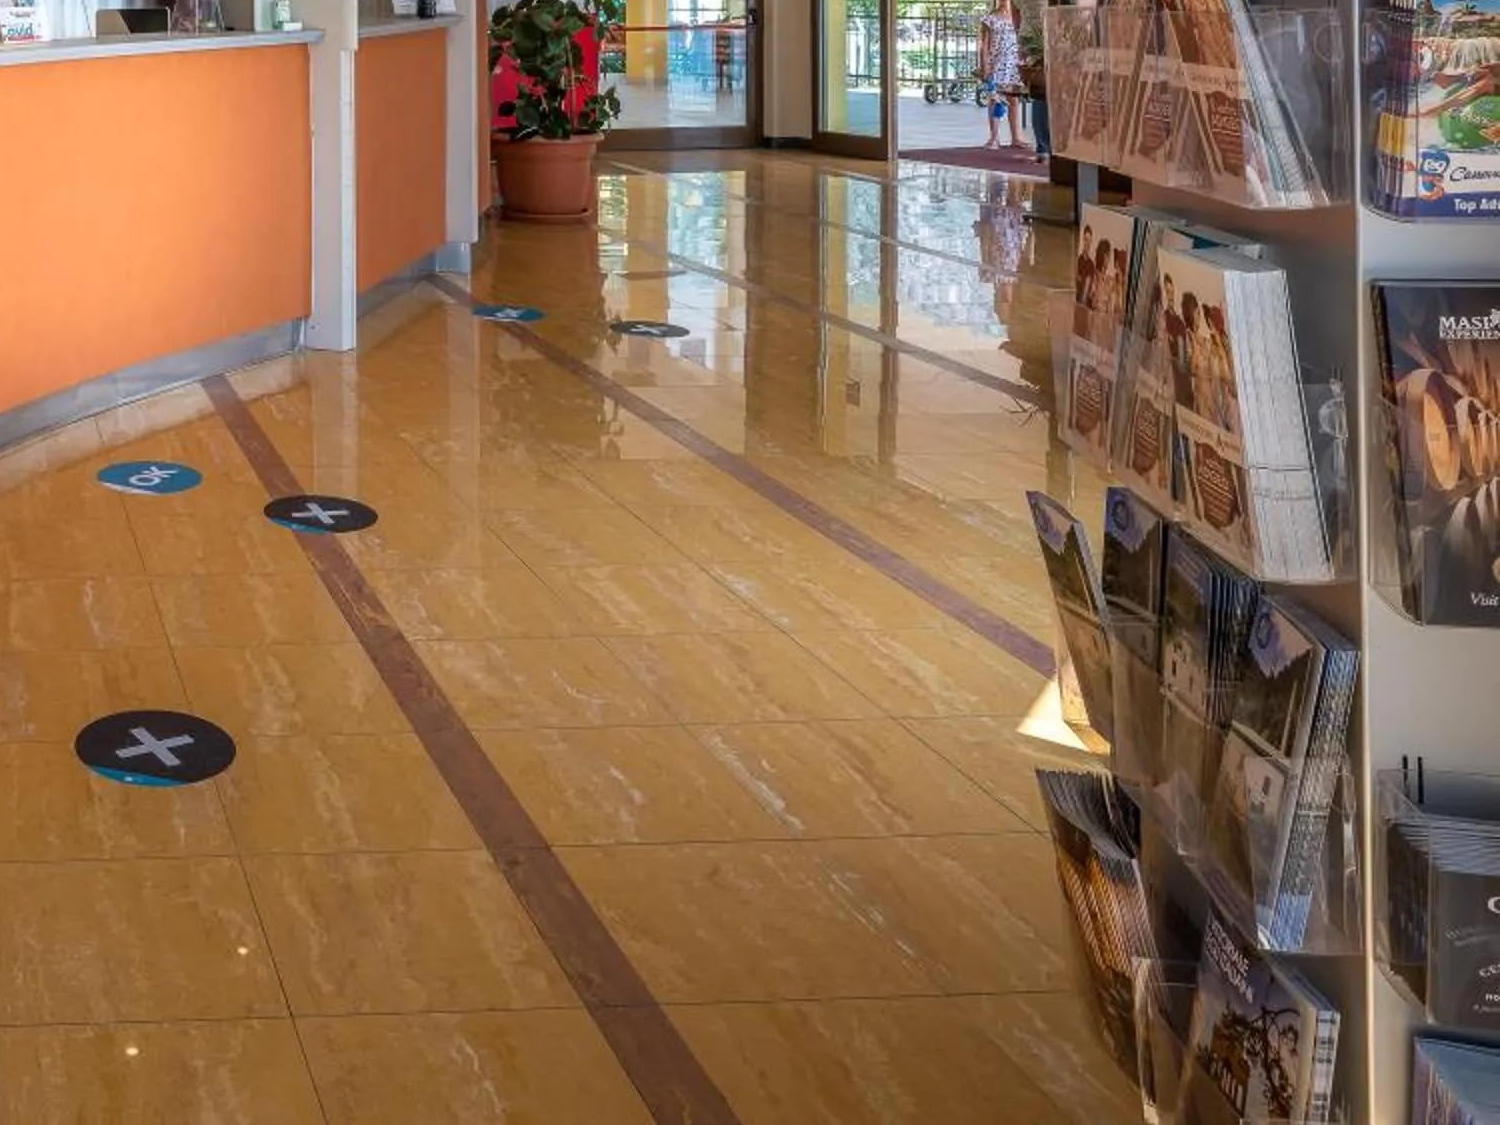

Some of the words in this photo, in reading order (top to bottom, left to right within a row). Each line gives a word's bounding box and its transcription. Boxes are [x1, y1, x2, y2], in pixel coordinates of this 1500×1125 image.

[1454, 198, 1476, 214] Top
[1480, 198, 1500, 209] Ad
[1439, 316, 1489, 329] MASI
[128, 465, 178, 487] OK
